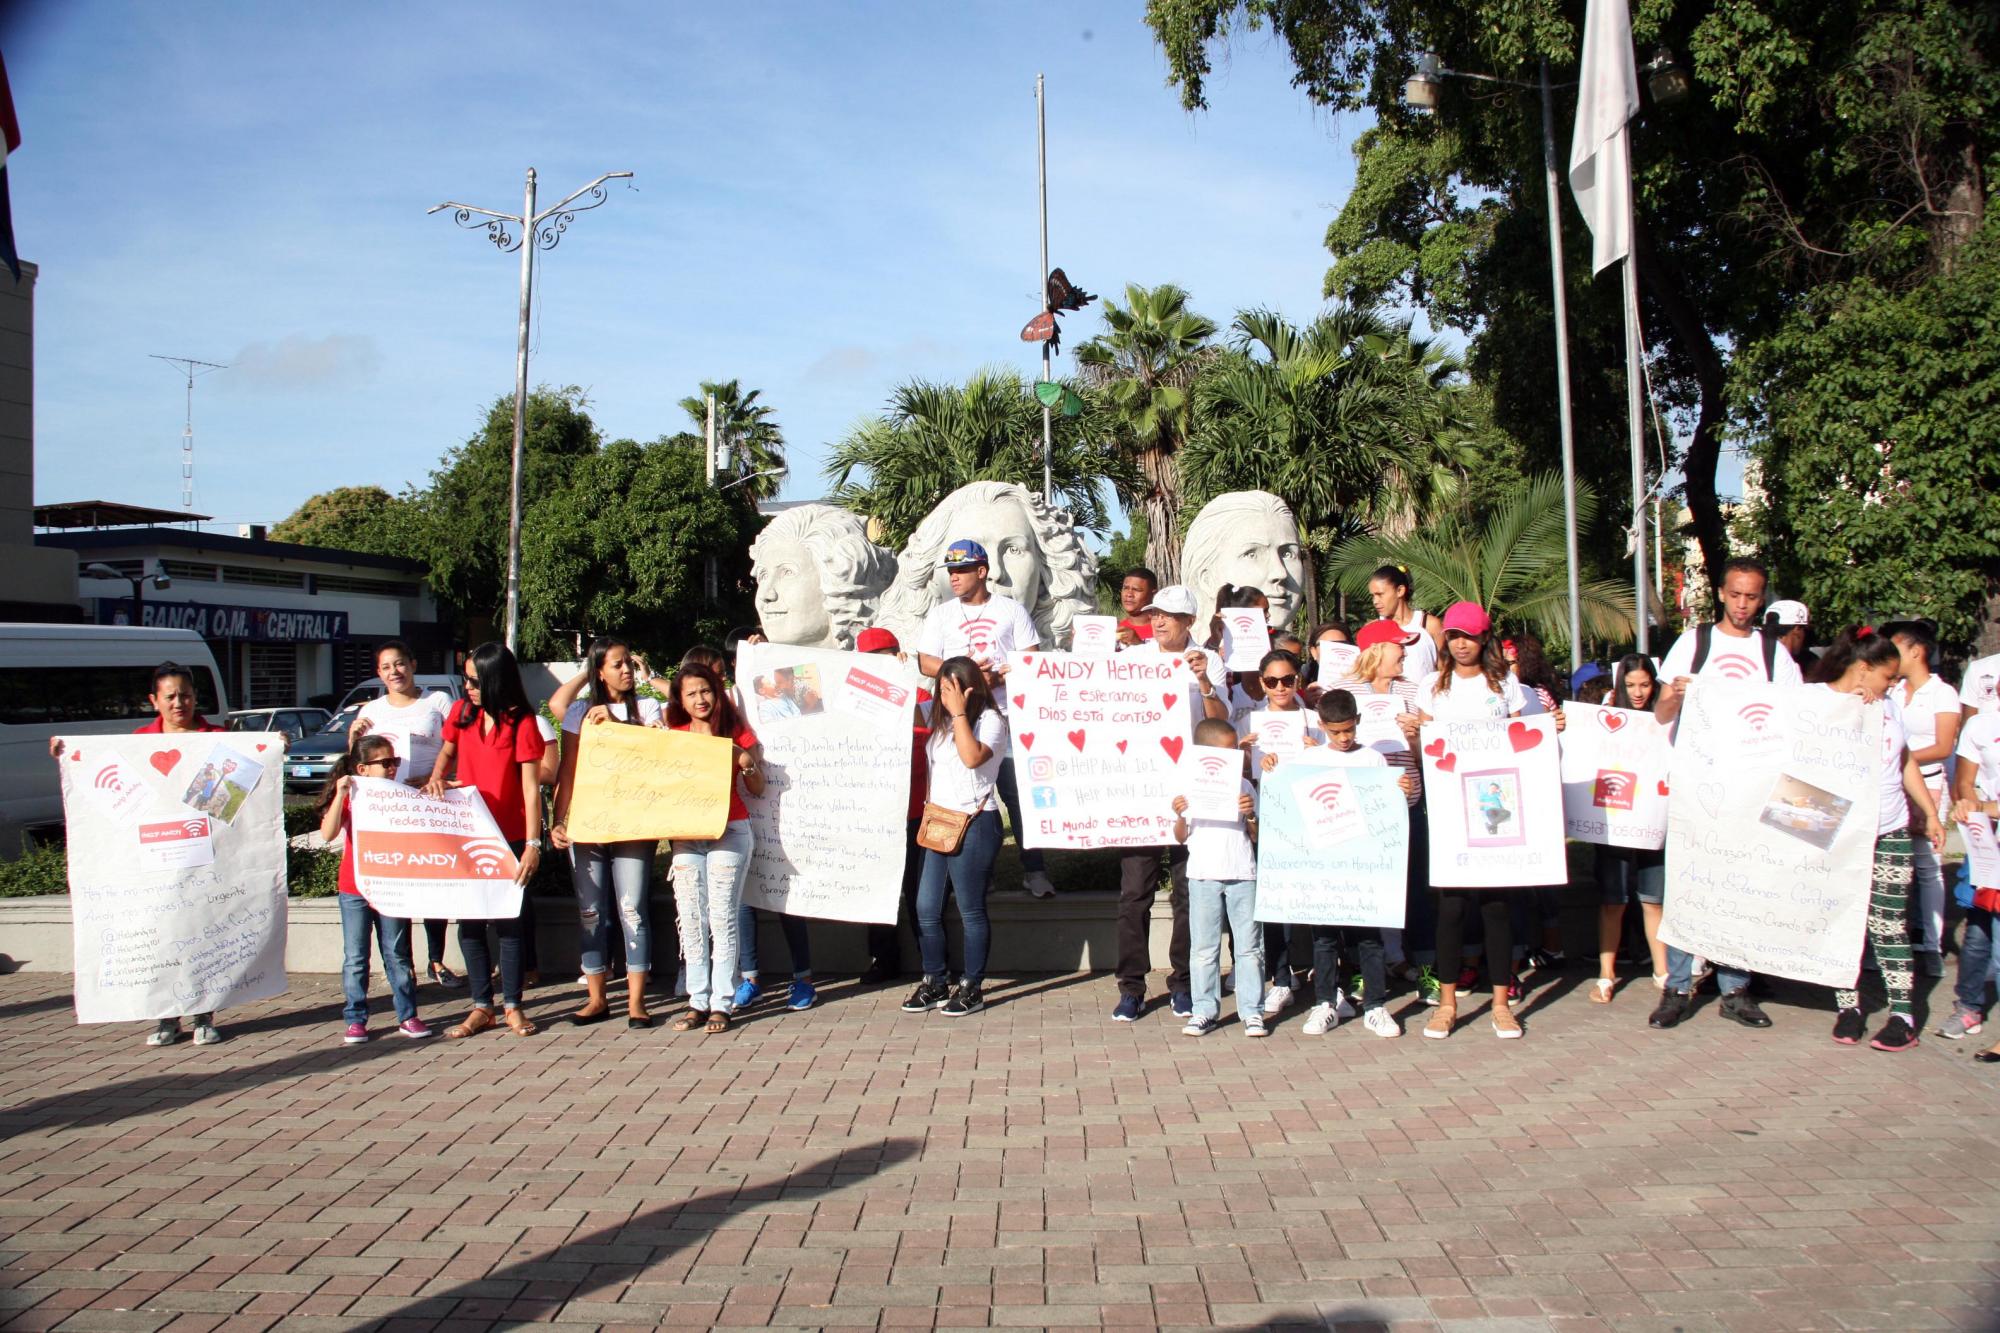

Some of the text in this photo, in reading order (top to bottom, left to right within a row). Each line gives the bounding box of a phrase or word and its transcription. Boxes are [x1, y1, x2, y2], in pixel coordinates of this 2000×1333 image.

[140, 604, 331, 639] BANCA O.M. CENTRAL
[1037, 657, 1172, 681] ANDY Herrera
[1052, 684, 1069, 702] Te
[1039, 706, 1068, 722] Dios
[1447, 720, 1507, 737] POR UN
[1447, 736, 1502, 753] NUEVO
[366, 787, 423, 804] Republica
[368, 802, 473, 821] ayuda a Andy en
[389, 816, 475, 833] redes sociales
[1062, 816, 1099, 833] Mundo
[363, 850, 458, 869] HELP ANDY
